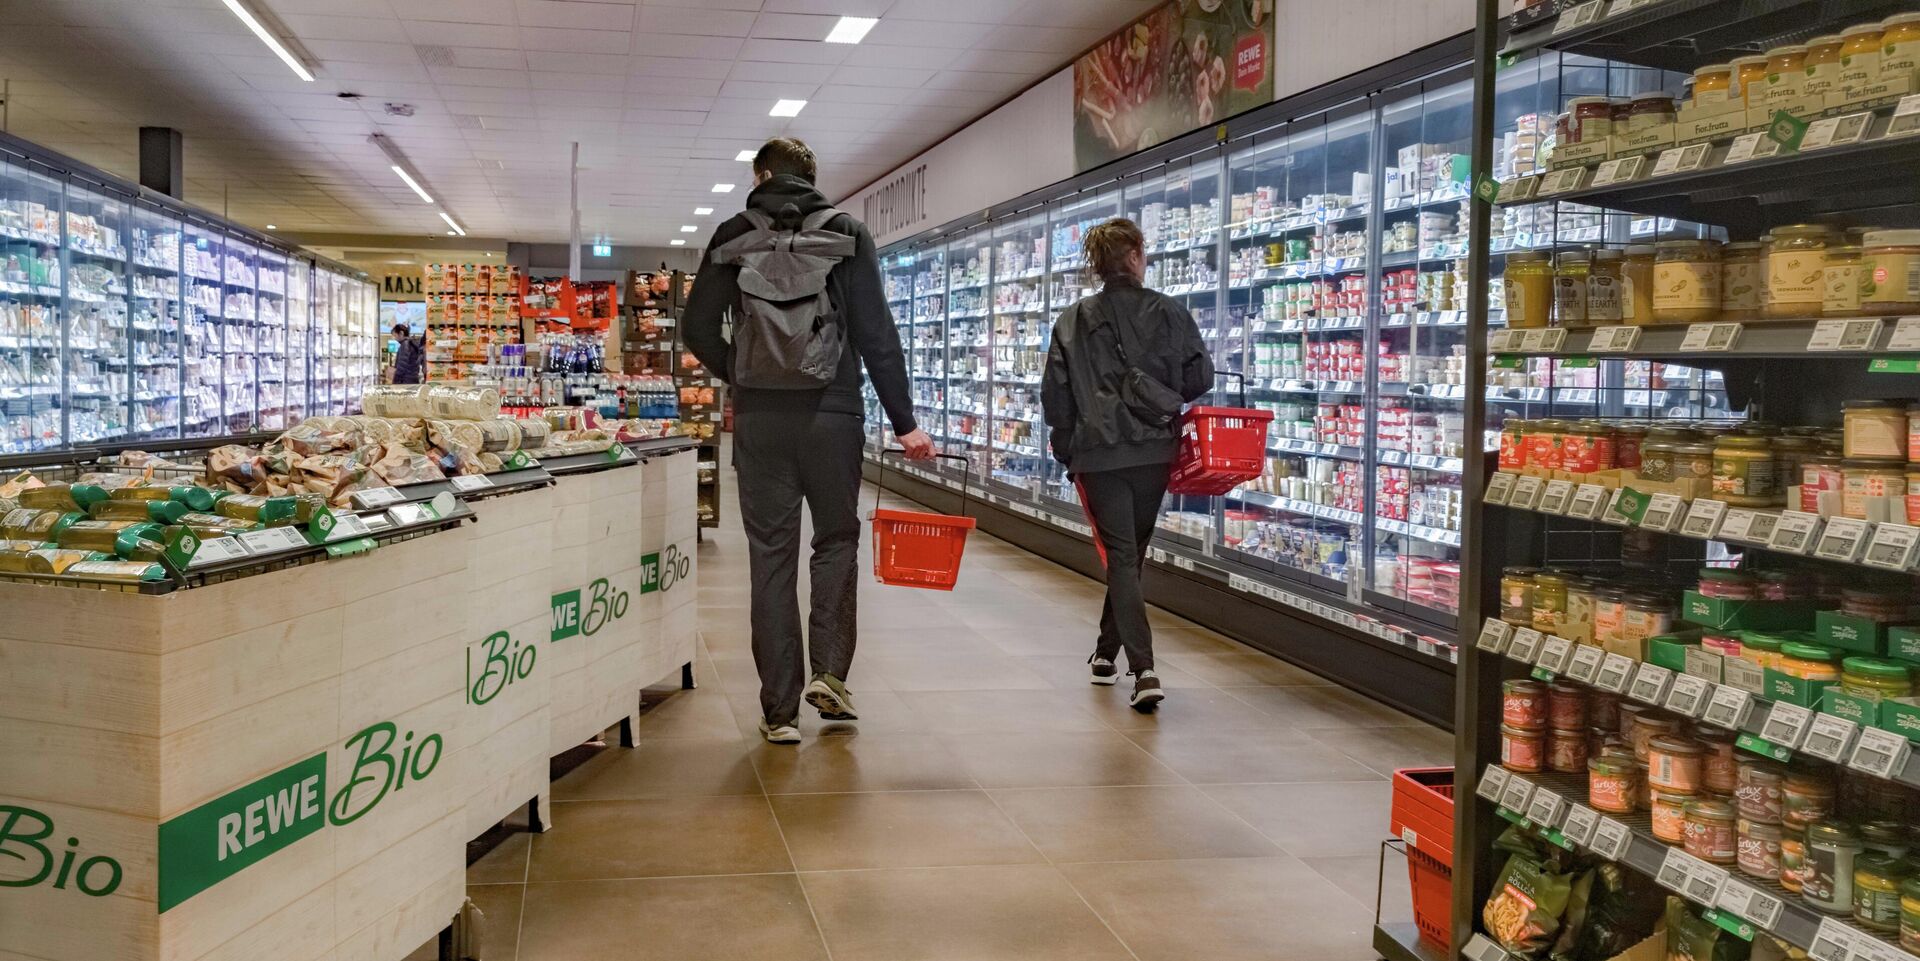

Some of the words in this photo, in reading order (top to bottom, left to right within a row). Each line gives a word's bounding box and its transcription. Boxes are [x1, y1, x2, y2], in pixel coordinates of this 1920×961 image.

[1238, 43, 1261, 65] REWE
[1695, 120, 1729, 134] Fior.frutta
[864, 164, 927, 239] MILCHPRODUKTE
[660, 543, 690, 592] Bio
[551, 601, 577, 631] WE
[581, 577, 629, 636] Bio
[471, 630, 536, 705] Bio
[217, 774, 319, 861] REWE
[328, 721, 443, 826] Bio
[0, 806, 122, 896] Bio
